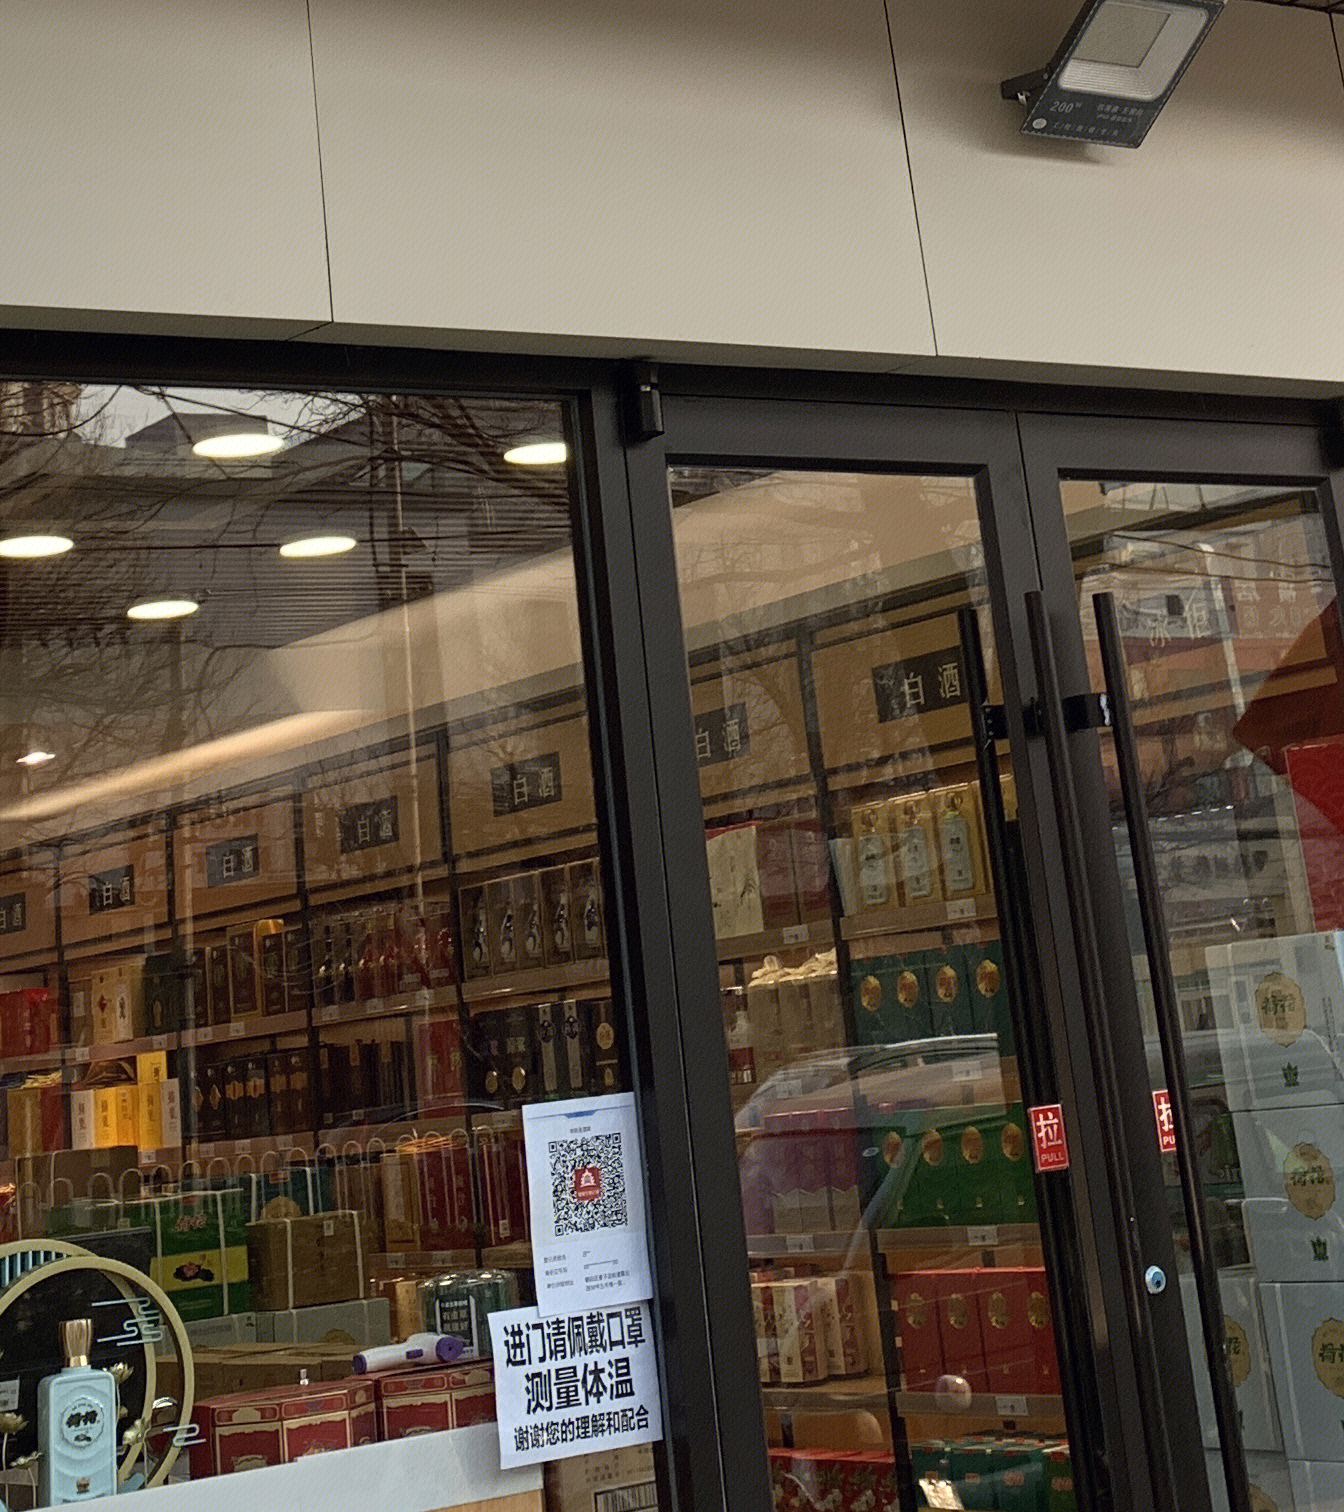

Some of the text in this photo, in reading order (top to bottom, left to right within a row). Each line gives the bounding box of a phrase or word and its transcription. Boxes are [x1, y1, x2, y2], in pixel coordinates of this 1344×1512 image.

[904, 662, 961, 708] 白酒
[695, 718, 742, 760] 白酒
[514, 767, 555, 805] 白酒
[1036, 1112, 1063, 1149] 拉
[1041, 1152, 1064, 1163] PULL
[503, 1306, 646, 1368] 进门请佩戴口罩
[525, 1356, 635, 1415] 测量体温
[513, 1404, 649, 1452] 谢谢您的理解和配合
